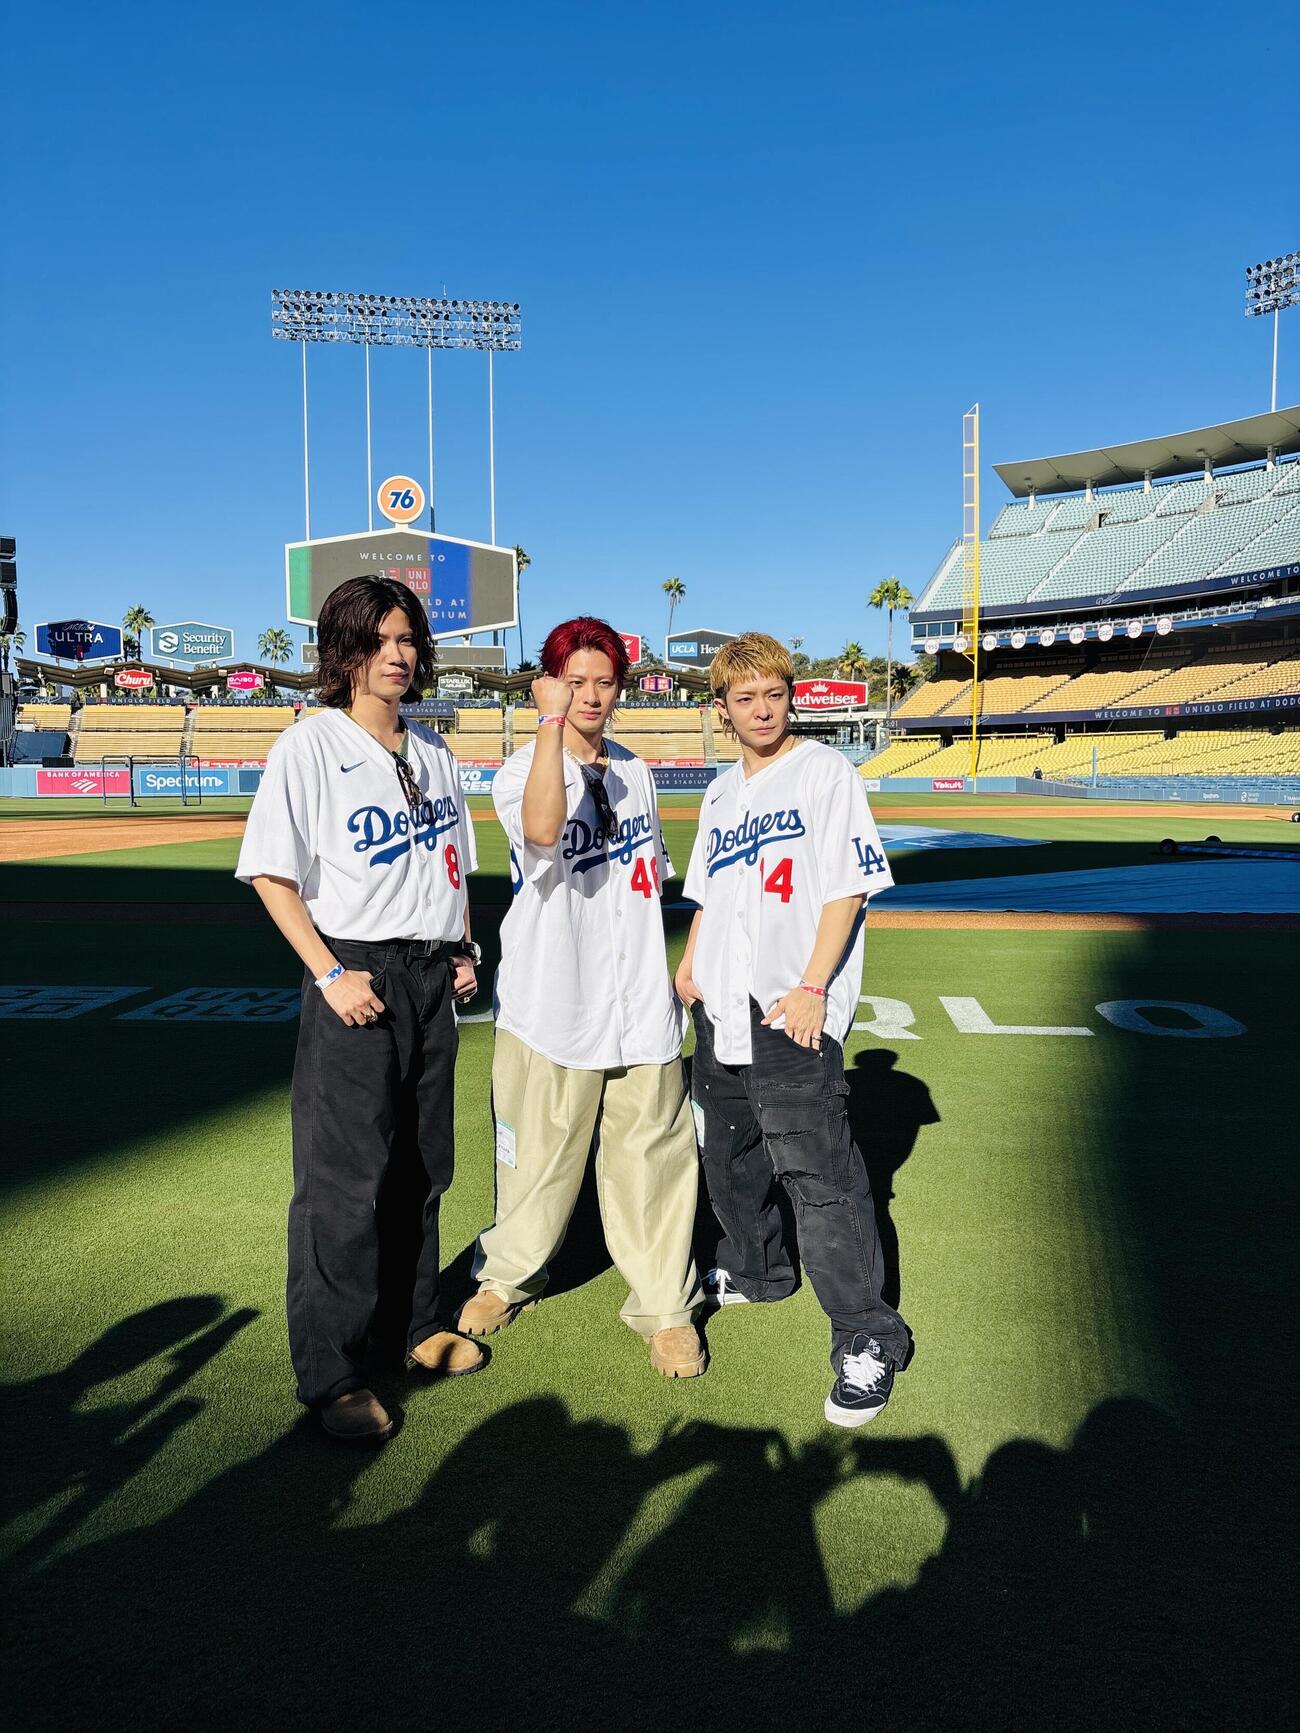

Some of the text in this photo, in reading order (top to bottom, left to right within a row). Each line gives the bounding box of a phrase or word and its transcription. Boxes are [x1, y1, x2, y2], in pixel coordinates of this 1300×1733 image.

[390, 489, 415, 509] 76
[359, 552, 446, 562] WELCOME TO
[408, 570, 427, 580] UNI
[1230, 566, 1300, 585] WELCOME TO
[421, 598, 465, 607] ELD AT
[428, 610, 467, 619] DIUM
[55, 631, 103, 644] ULTRA
[182, 631, 226, 647] Security
[183, 643, 221, 655] Benefit
[671, 644, 695, 654] UCLA
[116, 673, 150, 685] Churu
[792, 692, 858, 705] udweiser
[1095, 709, 1143, 719] WELCOME
[1148, 708, 1161, 716] TO
[1185, 703, 1224, 714] UNIQLO
[1228, 700, 1255, 710] FIELD
[1259, 699, 1271, 708] AT
[146, 773, 217, 791] Spectrum
[459, 770, 482, 781] YO
[460, 781, 492, 791] RES
[934, 781, 963, 789] Yakult
[562, 811, 653, 874] Dodger
[706, 809, 806, 877] Dodgers
[852, 837, 886, 876] LA
[445, 844, 460, 890] 8
[152, 1004, 288, 1017] QLO
